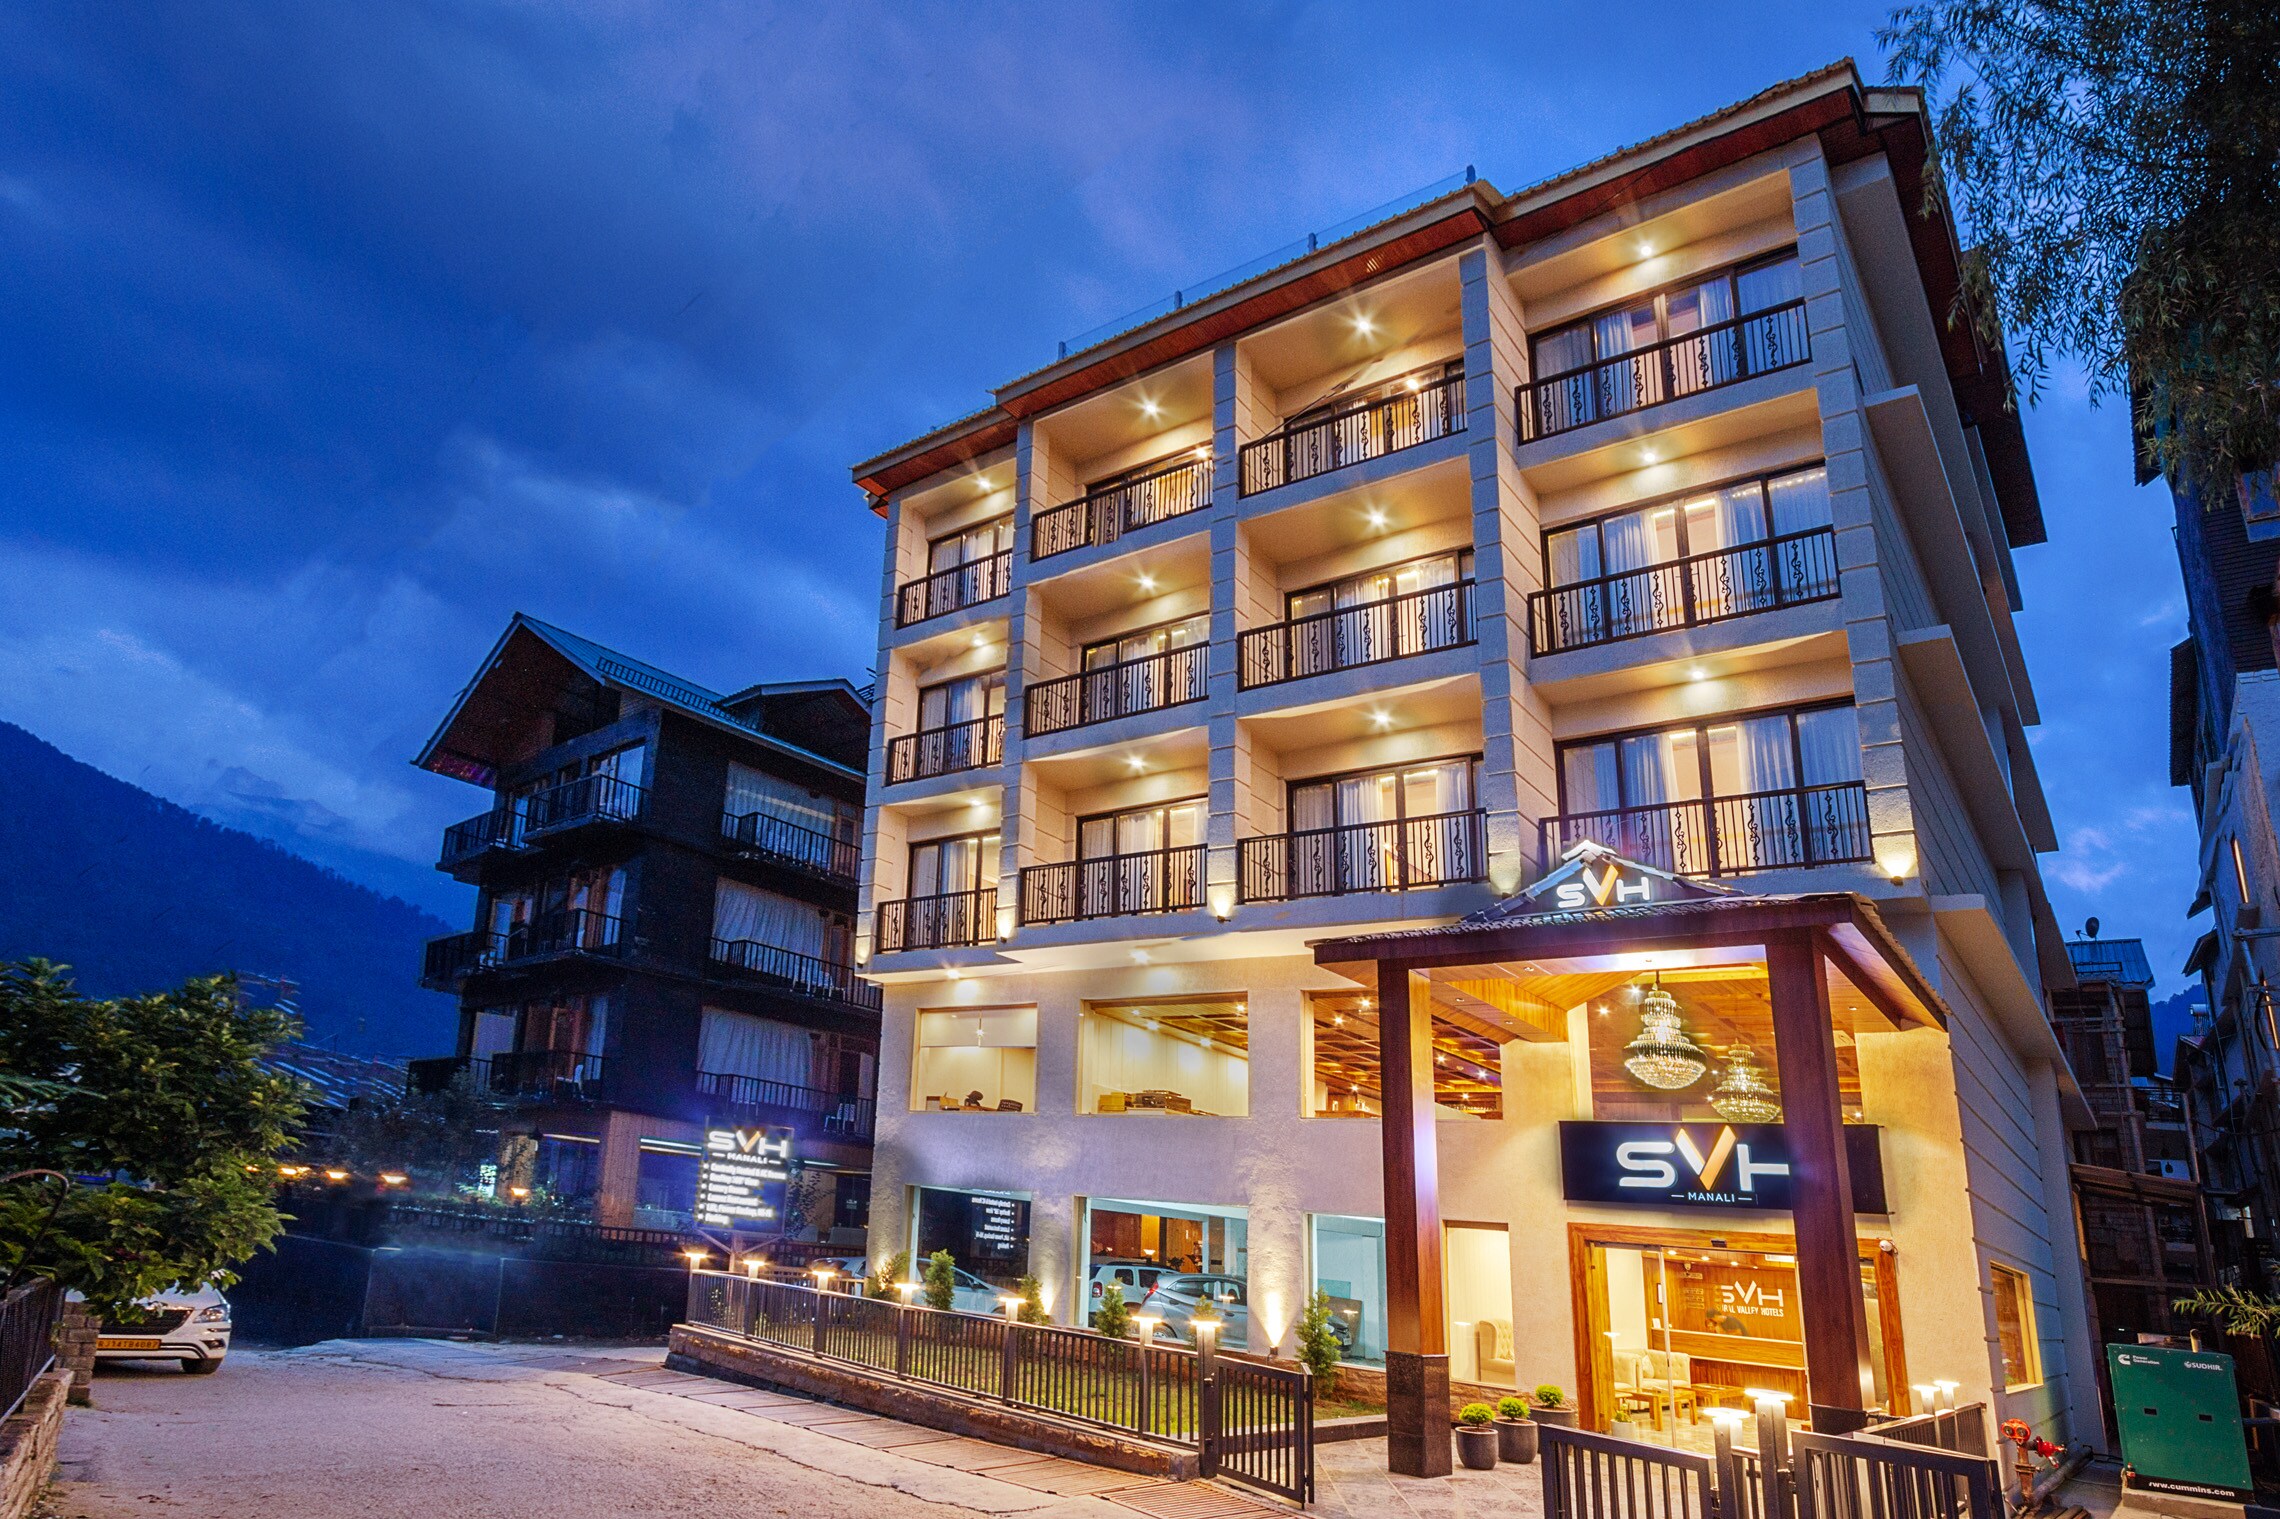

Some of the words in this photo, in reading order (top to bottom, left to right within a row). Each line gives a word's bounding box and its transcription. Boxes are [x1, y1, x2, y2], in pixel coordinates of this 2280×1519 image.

[1556, 864, 1650, 909] SVH
[707, 1130, 788, 1158] SVH
[1616, 1124, 1790, 1191] SVH
[727, 1152, 768, 1164] MANALI
[1688, 1191, 1736, 1203] MANALI
[1714, 1280, 1784, 1307] SVH
[1760, 1307, 1784, 1317] HOTELS
